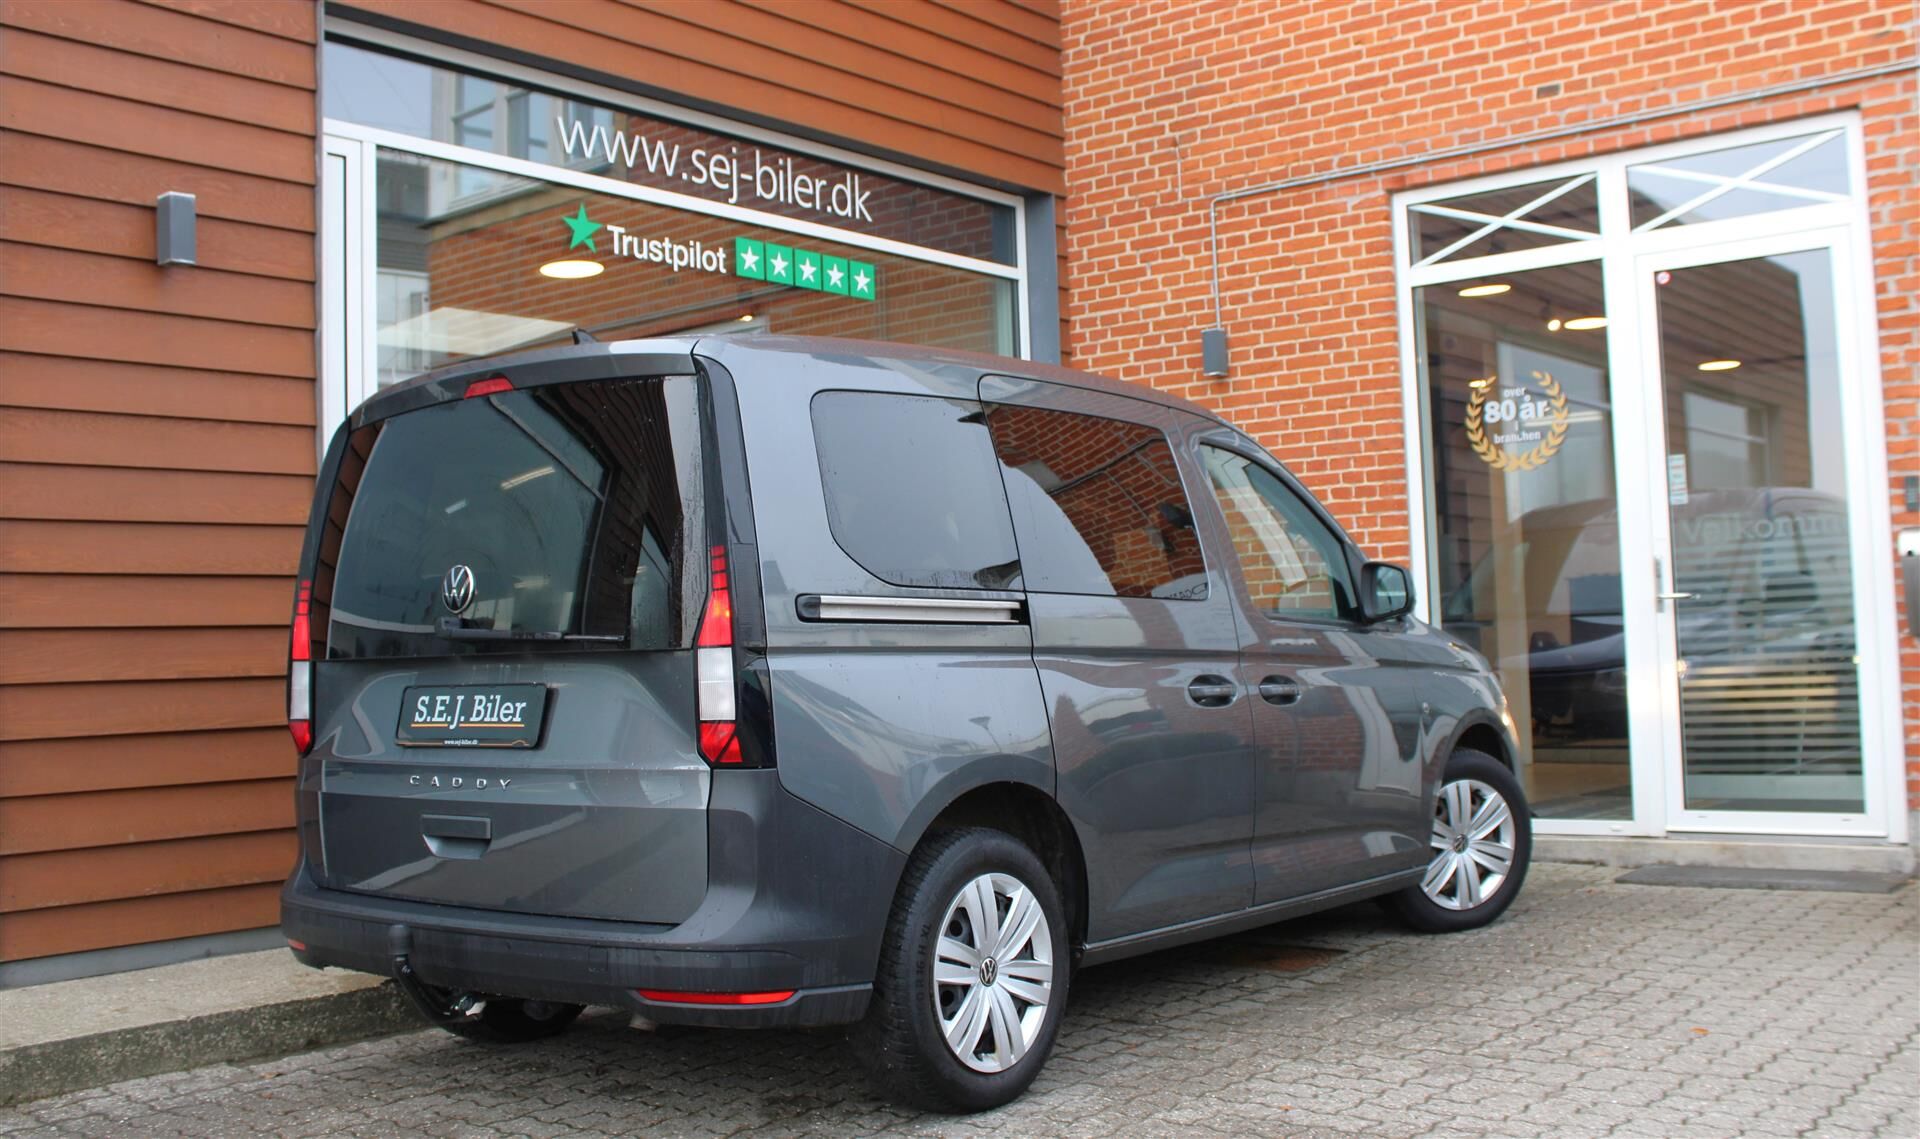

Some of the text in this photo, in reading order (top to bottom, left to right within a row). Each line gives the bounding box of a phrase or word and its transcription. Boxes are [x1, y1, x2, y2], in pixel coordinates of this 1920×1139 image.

[557, 116, 873, 222] www.sej-biler.dk
[606, 224, 727, 274] Trustpilot
[1484, 394, 1548, 424] 80 år
[1503, 387, 1526, 398] over
[414, 694, 527, 730] S.E.J. Biler
[409, 775, 511, 791] CADDY
